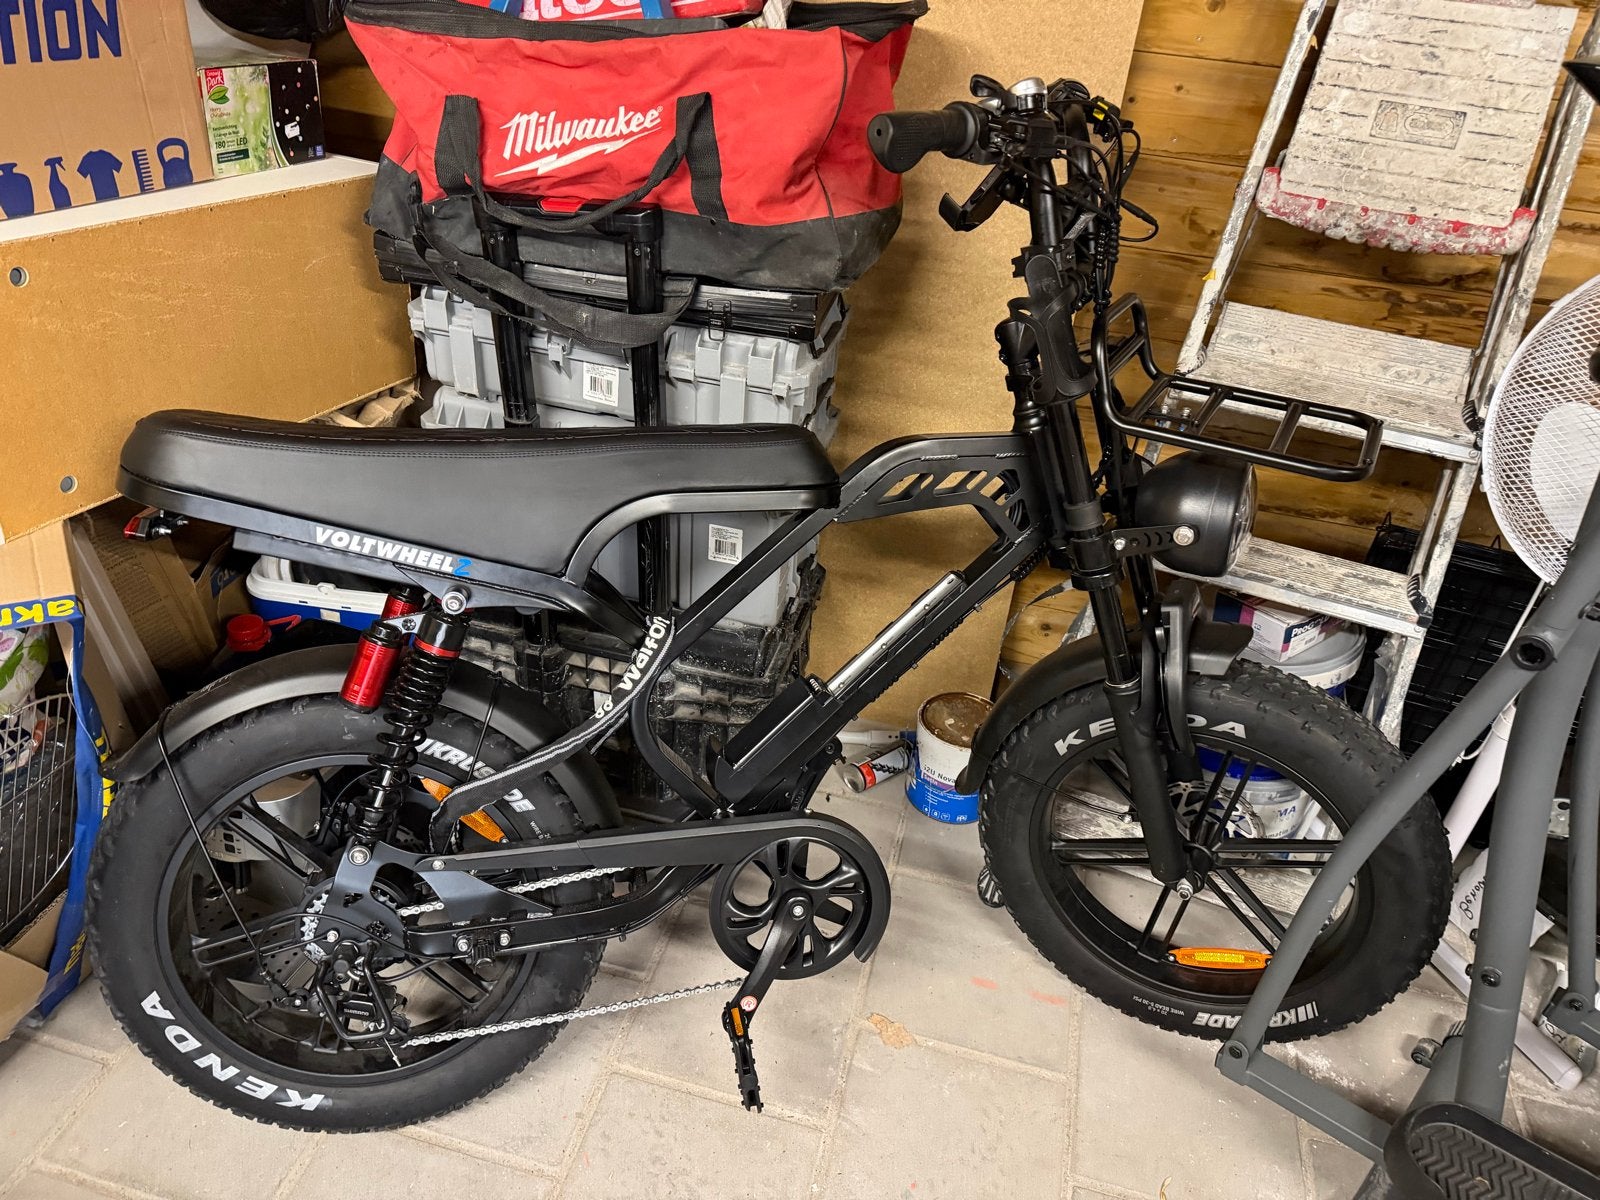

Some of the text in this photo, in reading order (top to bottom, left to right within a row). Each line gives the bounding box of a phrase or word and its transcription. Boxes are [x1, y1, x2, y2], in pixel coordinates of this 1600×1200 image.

[215, 140, 226, 149] 180
[236, 136, 248, 146] LED
[0, 599, 83, 627] akr
[1054, 713, 1247, 757] KEDA
[1193, 1009, 1297, 1029] KRADE
[140, 990, 325, 1112] KENDA
